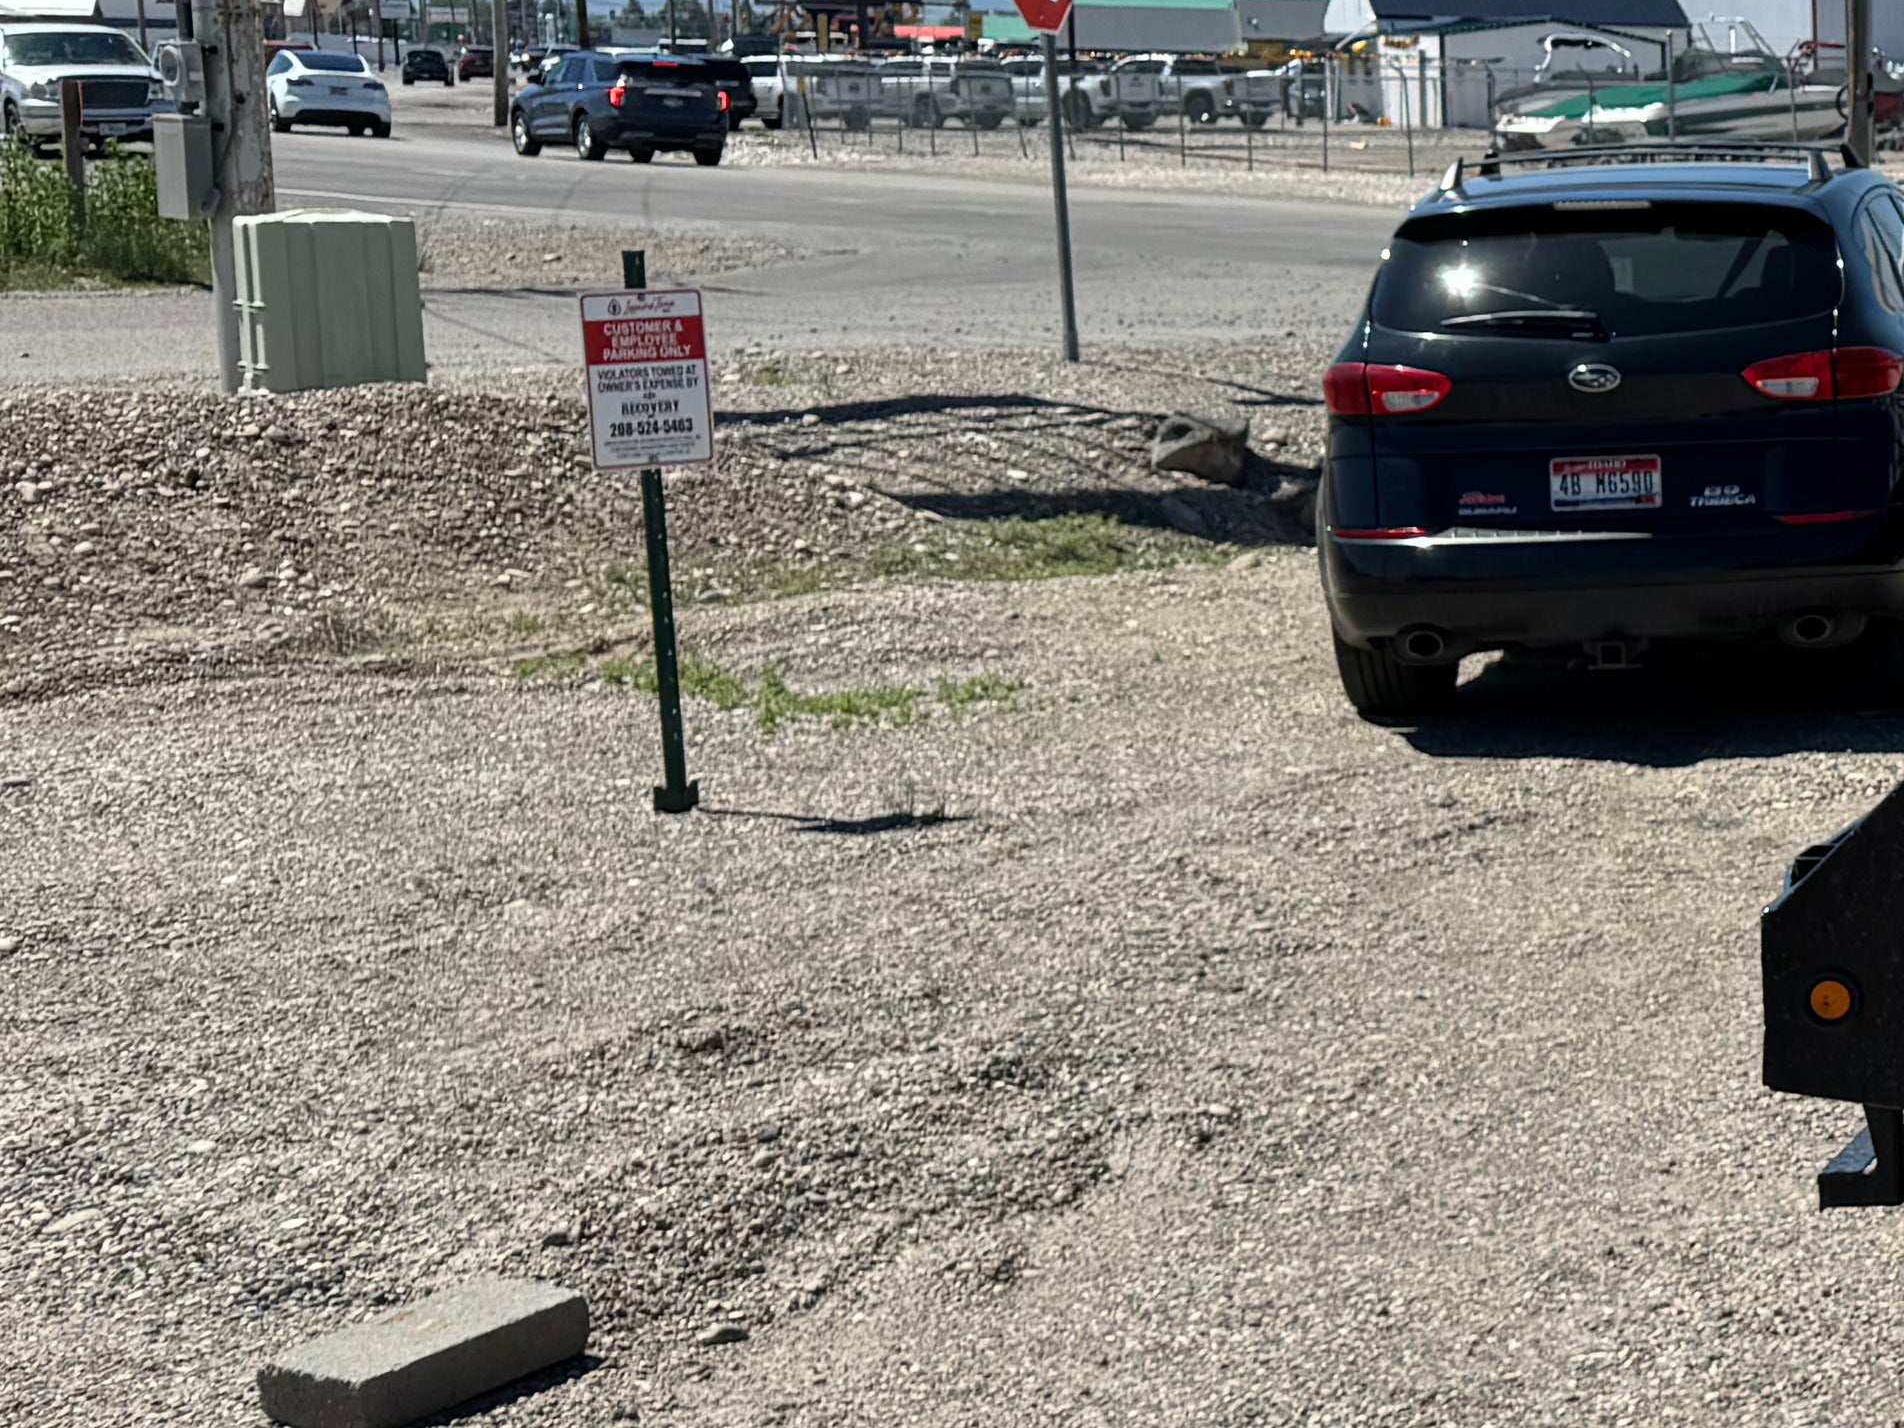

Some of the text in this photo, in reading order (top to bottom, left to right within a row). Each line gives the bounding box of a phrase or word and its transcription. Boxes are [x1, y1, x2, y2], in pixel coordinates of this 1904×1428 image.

[603, 319, 683, 337] CUSTOMER &
[611, 332, 678, 348] EMPLOYEE
[603, 344, 691, 361] PARKING ONLY
[597, 364, 697, 380] VIOLATORS TOWED AT
[597, 380, 641, 393] OWNER'S
[643, 377, 684, 391] EXPENSE
[621, 400, 680, 416] RECOVERY
[1559, 474, 1582, 495] 4B
